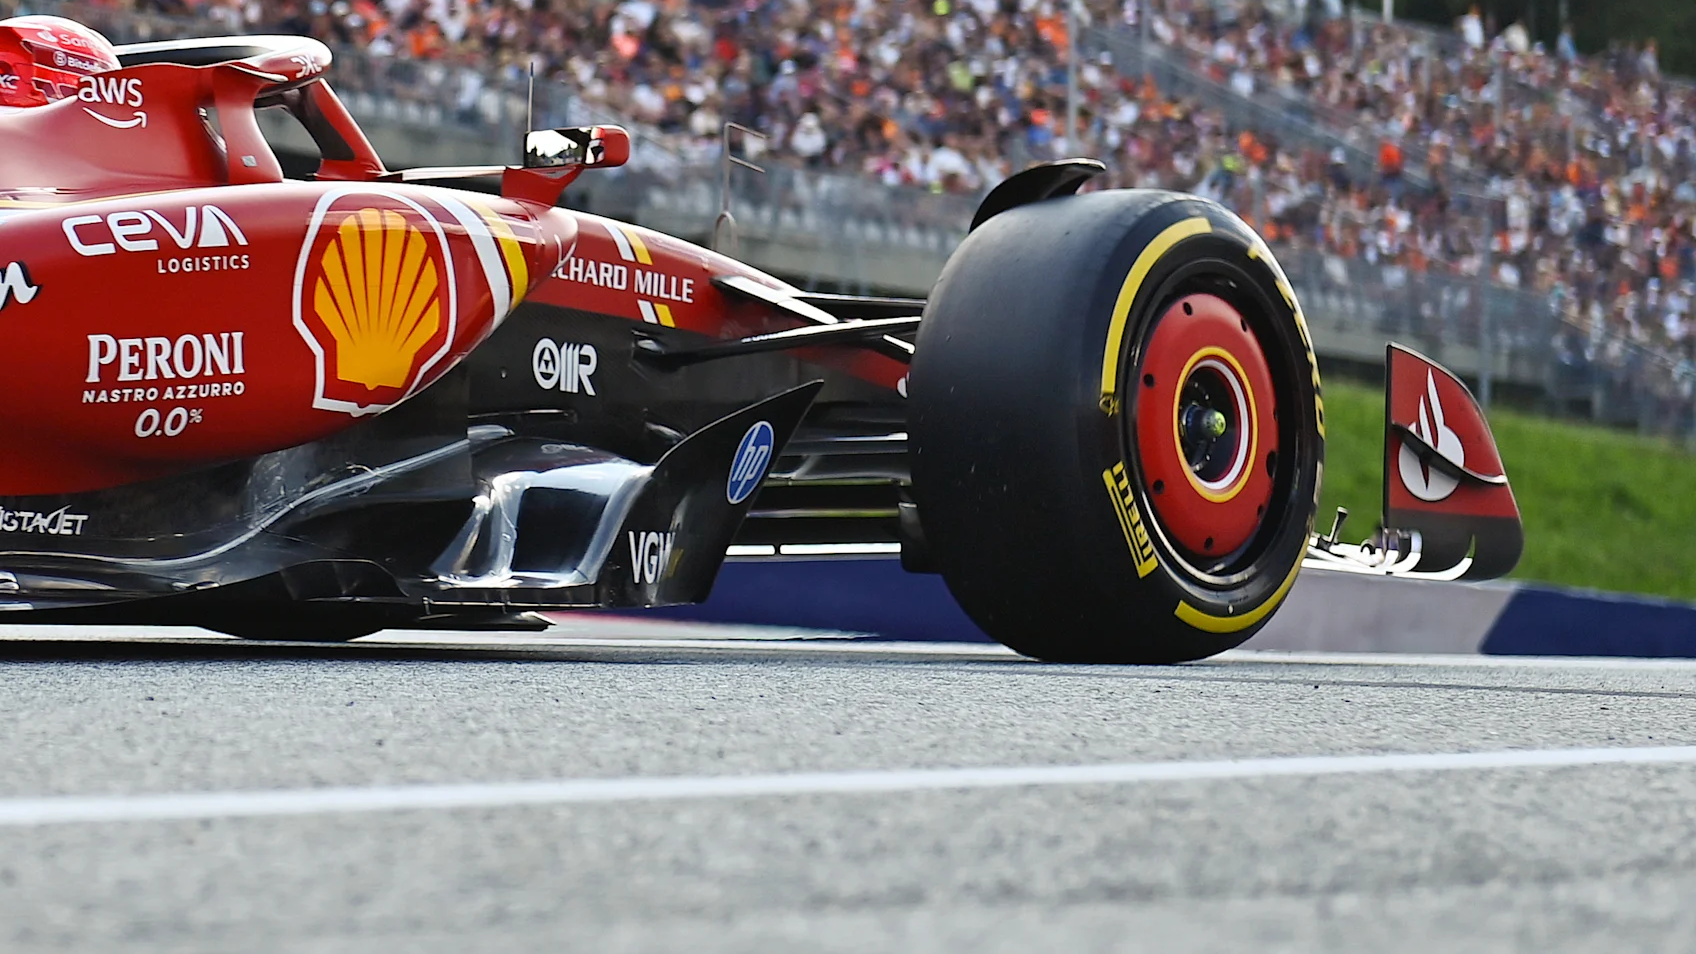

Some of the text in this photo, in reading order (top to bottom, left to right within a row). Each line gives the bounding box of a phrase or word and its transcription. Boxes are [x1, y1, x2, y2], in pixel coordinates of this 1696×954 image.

[78, 75, 144, 108] aws
[157, 254, 250, 273] LOGISTICS
[634, 269, 694, 303] MILLE
[85, 331, 245, 383] PERONI
[82, 381, 246, 403] NASTRO AZZURRO
[135, 406, 203, 437] 0.0%
[731, 423, 772, 502] hp
